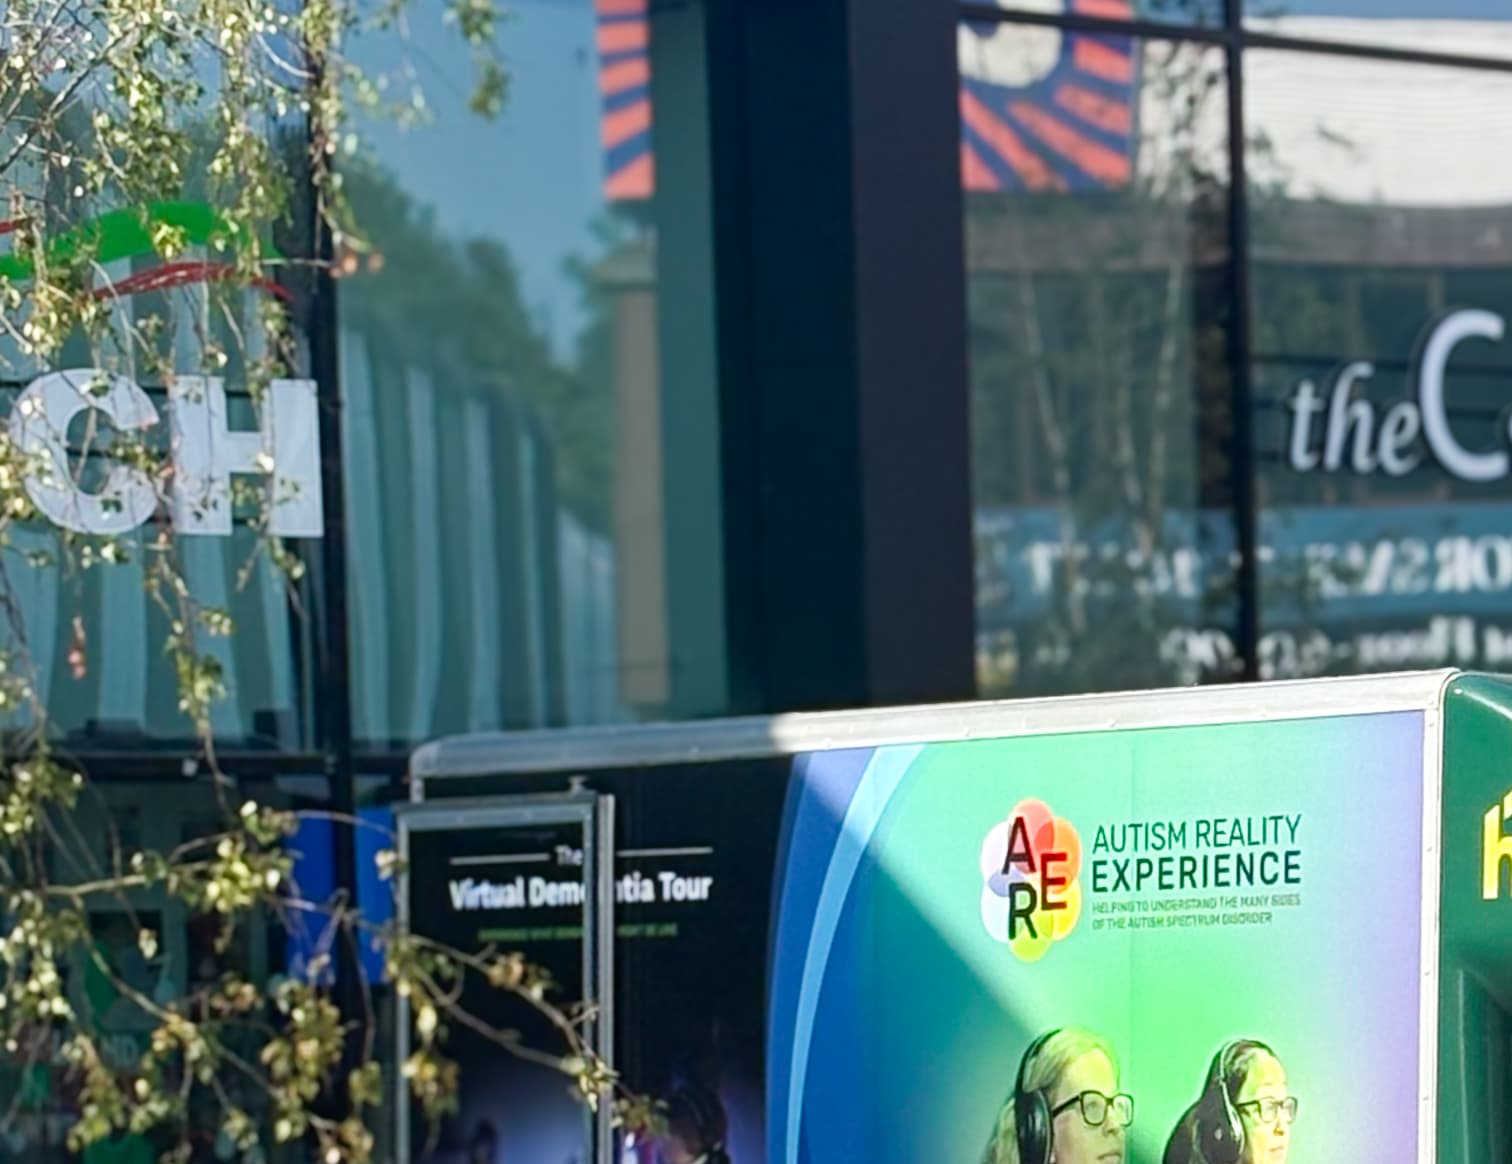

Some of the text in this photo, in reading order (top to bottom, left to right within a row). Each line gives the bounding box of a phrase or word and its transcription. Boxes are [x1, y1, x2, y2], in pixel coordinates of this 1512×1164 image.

[1092, 814, 1302, 854] AUTISM REALITY
[449, 871, 713, 910] Virtual Demtia Tour
[1092, 850, 1302, 893] EXPERIENCE
[1092, 899, 1134, 914] HELPING
[1136, 900, 1149, 913] TO
[1150, 897, 1216, 912] UNDERSTAND
[1220, 896, 1238, 909] THE
[1108, 917, 1125, 929] THE
[1128, 916, 1164, 929] AUTISM
[1166, 913, 1220, 928] SPECTRUM
